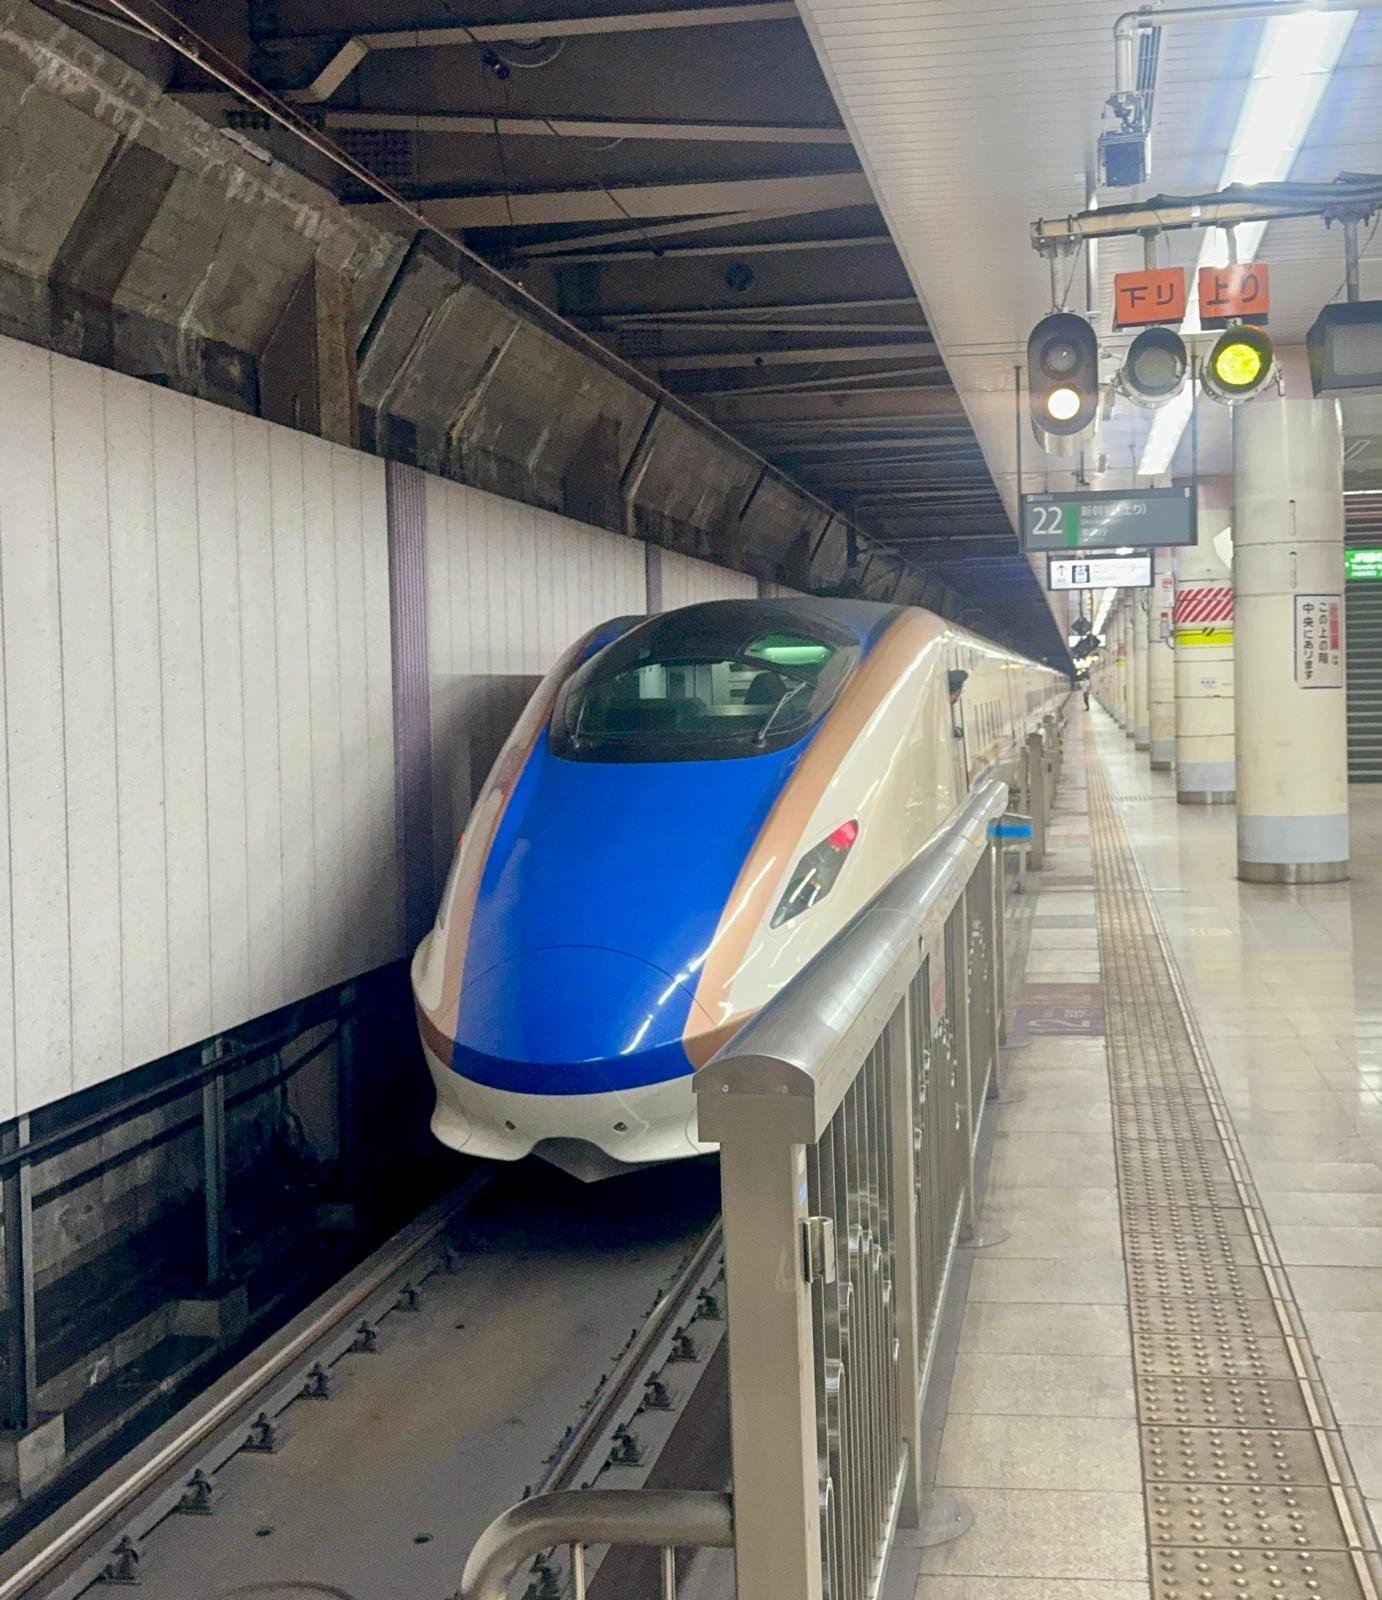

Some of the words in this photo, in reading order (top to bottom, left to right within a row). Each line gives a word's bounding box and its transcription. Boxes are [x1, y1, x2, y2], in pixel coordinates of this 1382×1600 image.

[1206, 273, 1259, 304] 上り
[1032, 506, 1063, 535] 22
[1303, 602, 1314, 680] 中央にあります
[1318, 602, 1329, 664] この上の階
